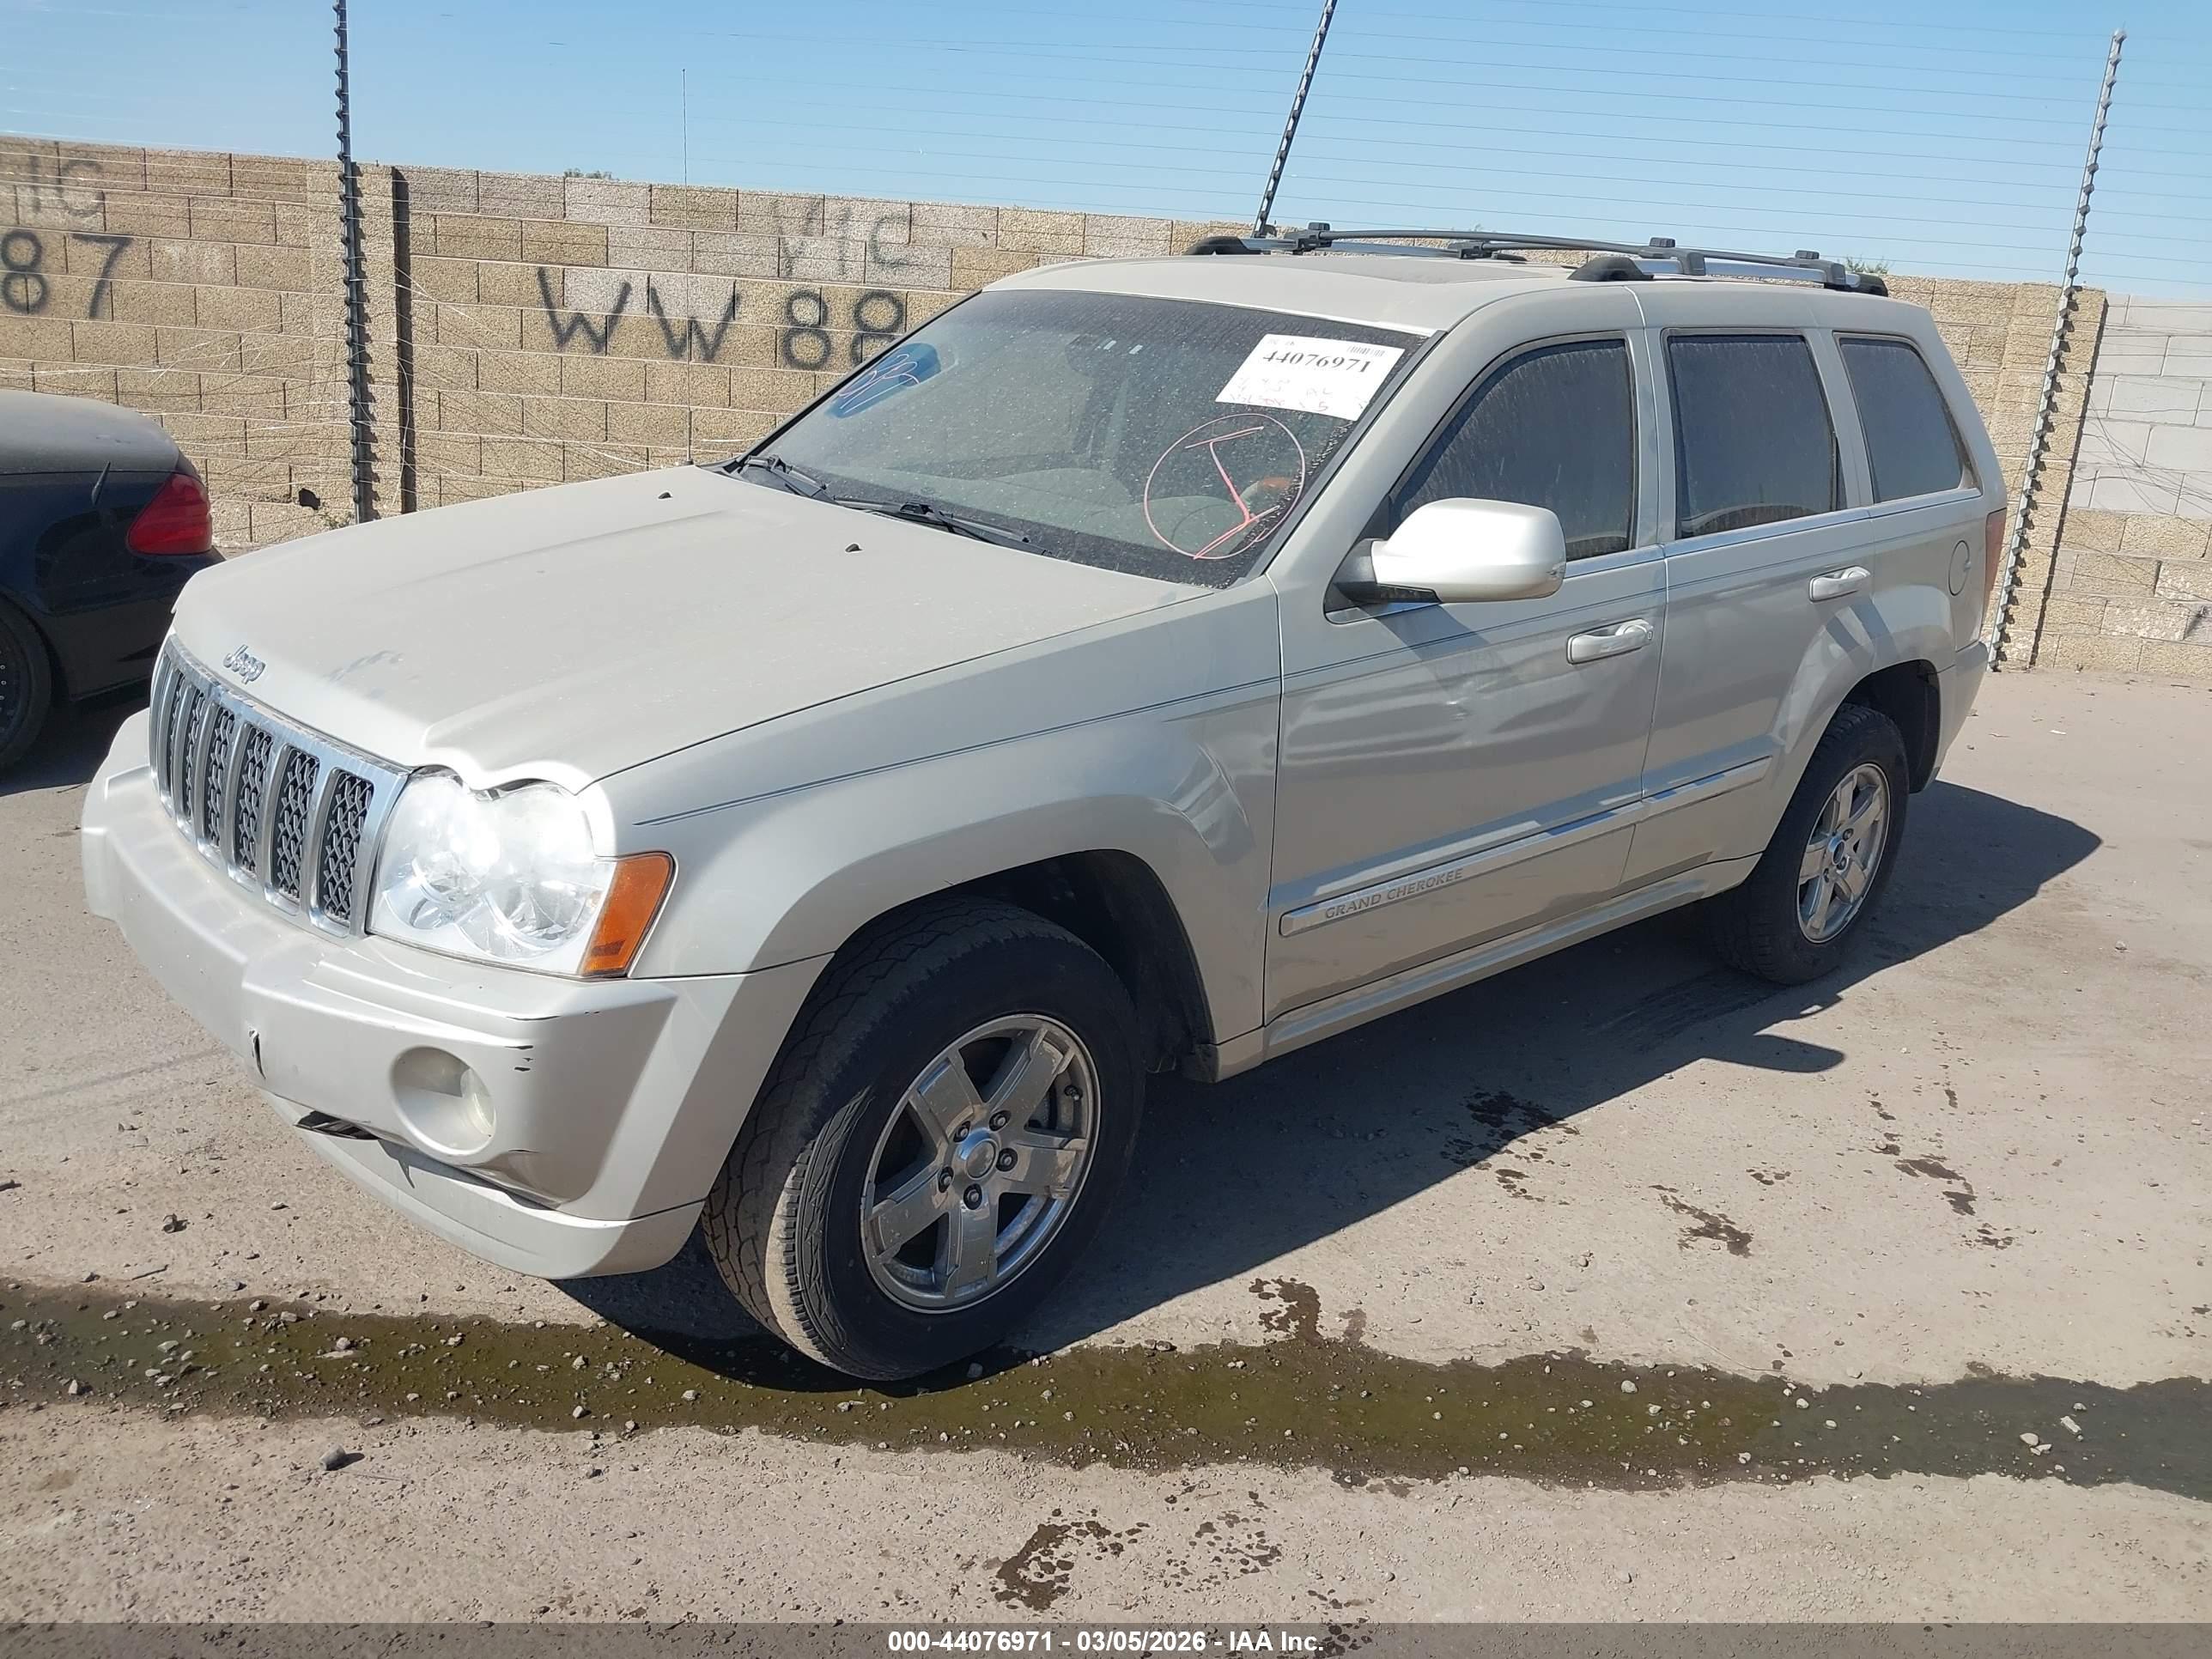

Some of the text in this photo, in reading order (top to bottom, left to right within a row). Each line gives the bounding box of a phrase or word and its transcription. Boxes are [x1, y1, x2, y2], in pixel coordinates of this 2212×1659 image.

[0, 229, 133, 319] 87
[1262, 350, 1376, 374] 44076971
[222, 644, 266, 685] Jeep
[1324, 867, 1464, 919] GRAND CHEROKEE
